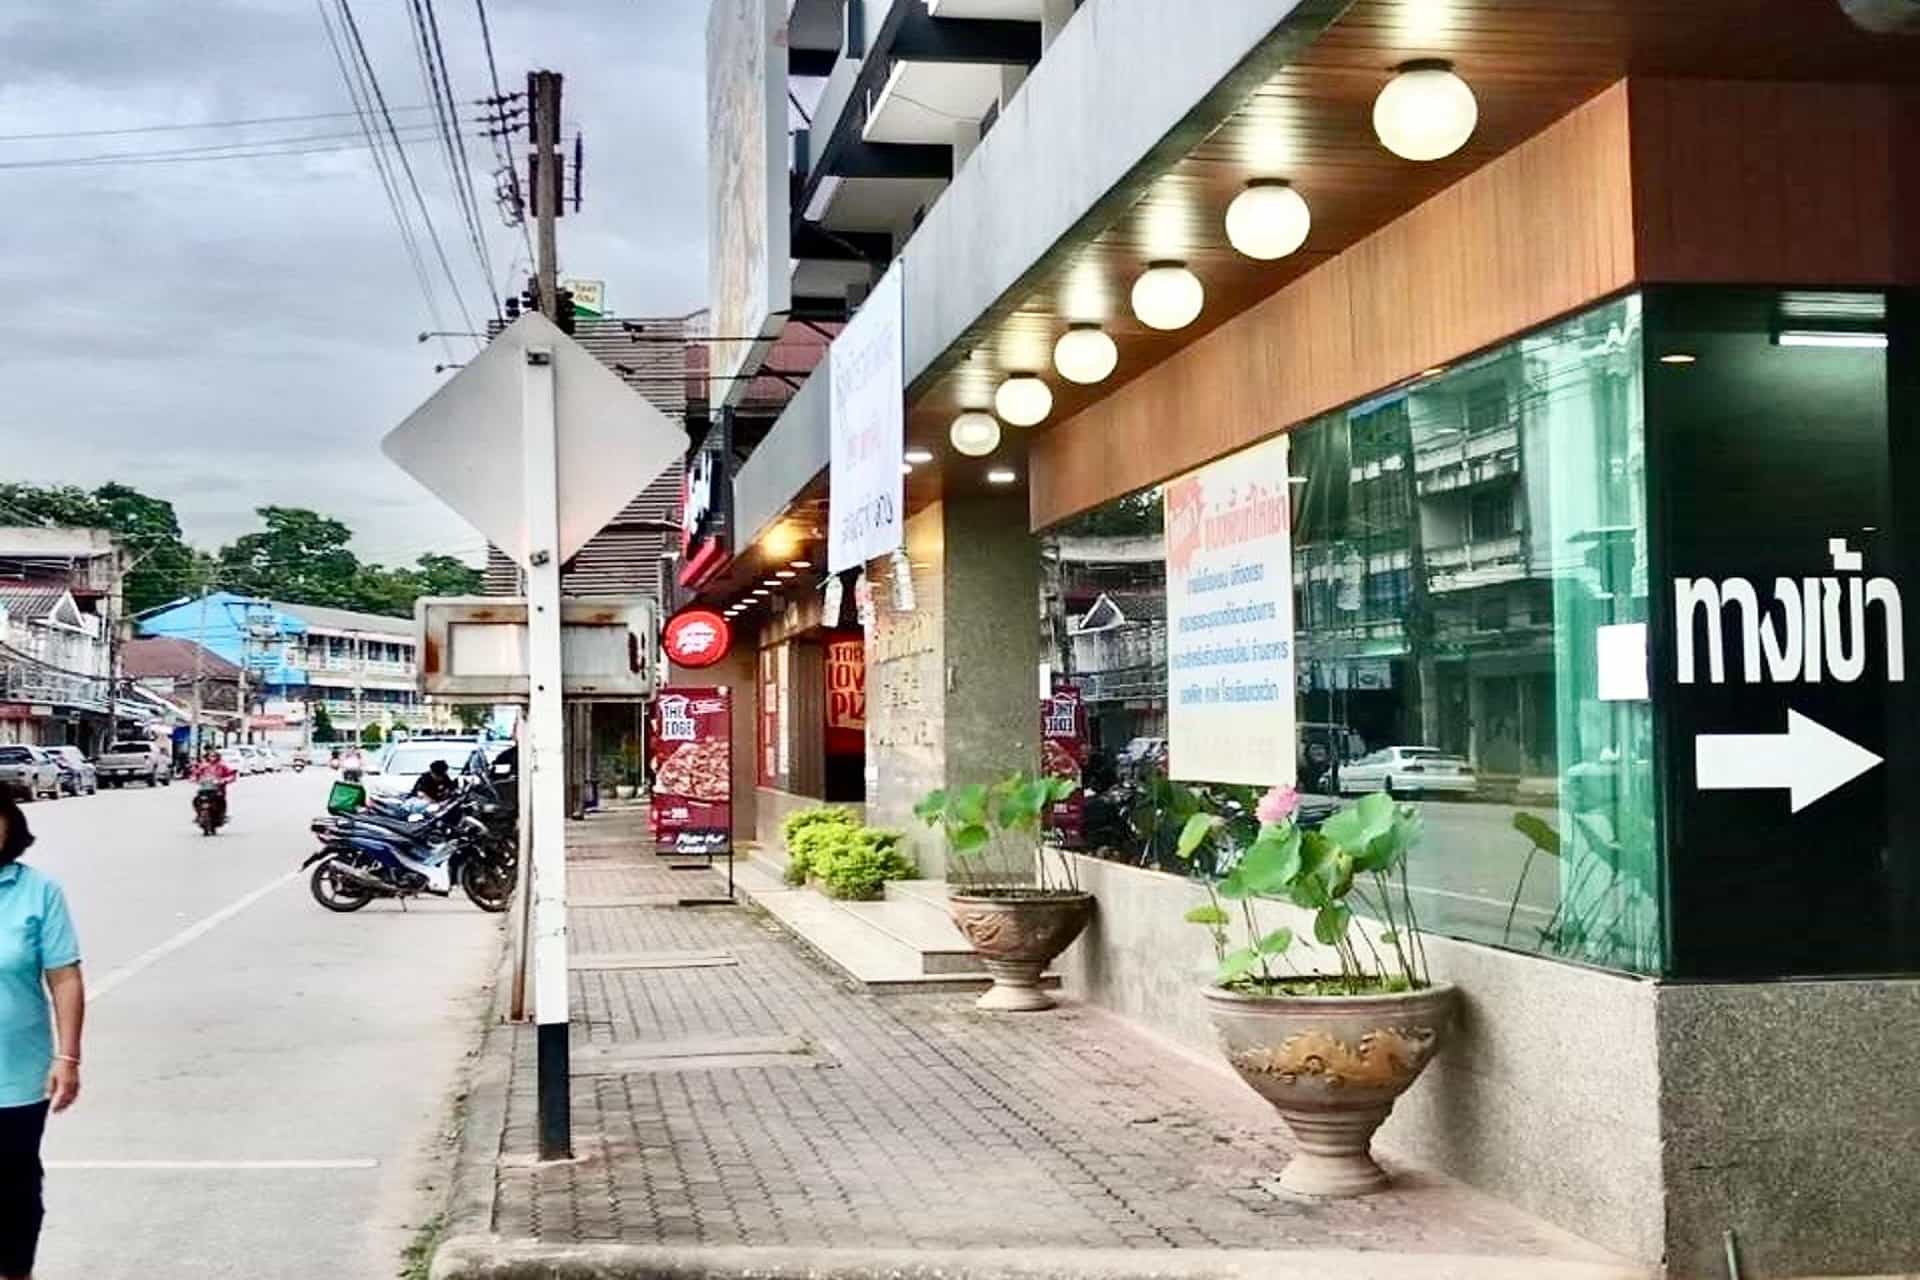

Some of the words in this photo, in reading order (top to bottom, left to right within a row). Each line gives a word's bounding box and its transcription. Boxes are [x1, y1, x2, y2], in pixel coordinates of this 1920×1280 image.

[1674, 538, 1904, 683] ทางเข้า
[664, 704, 683, 719] THE
